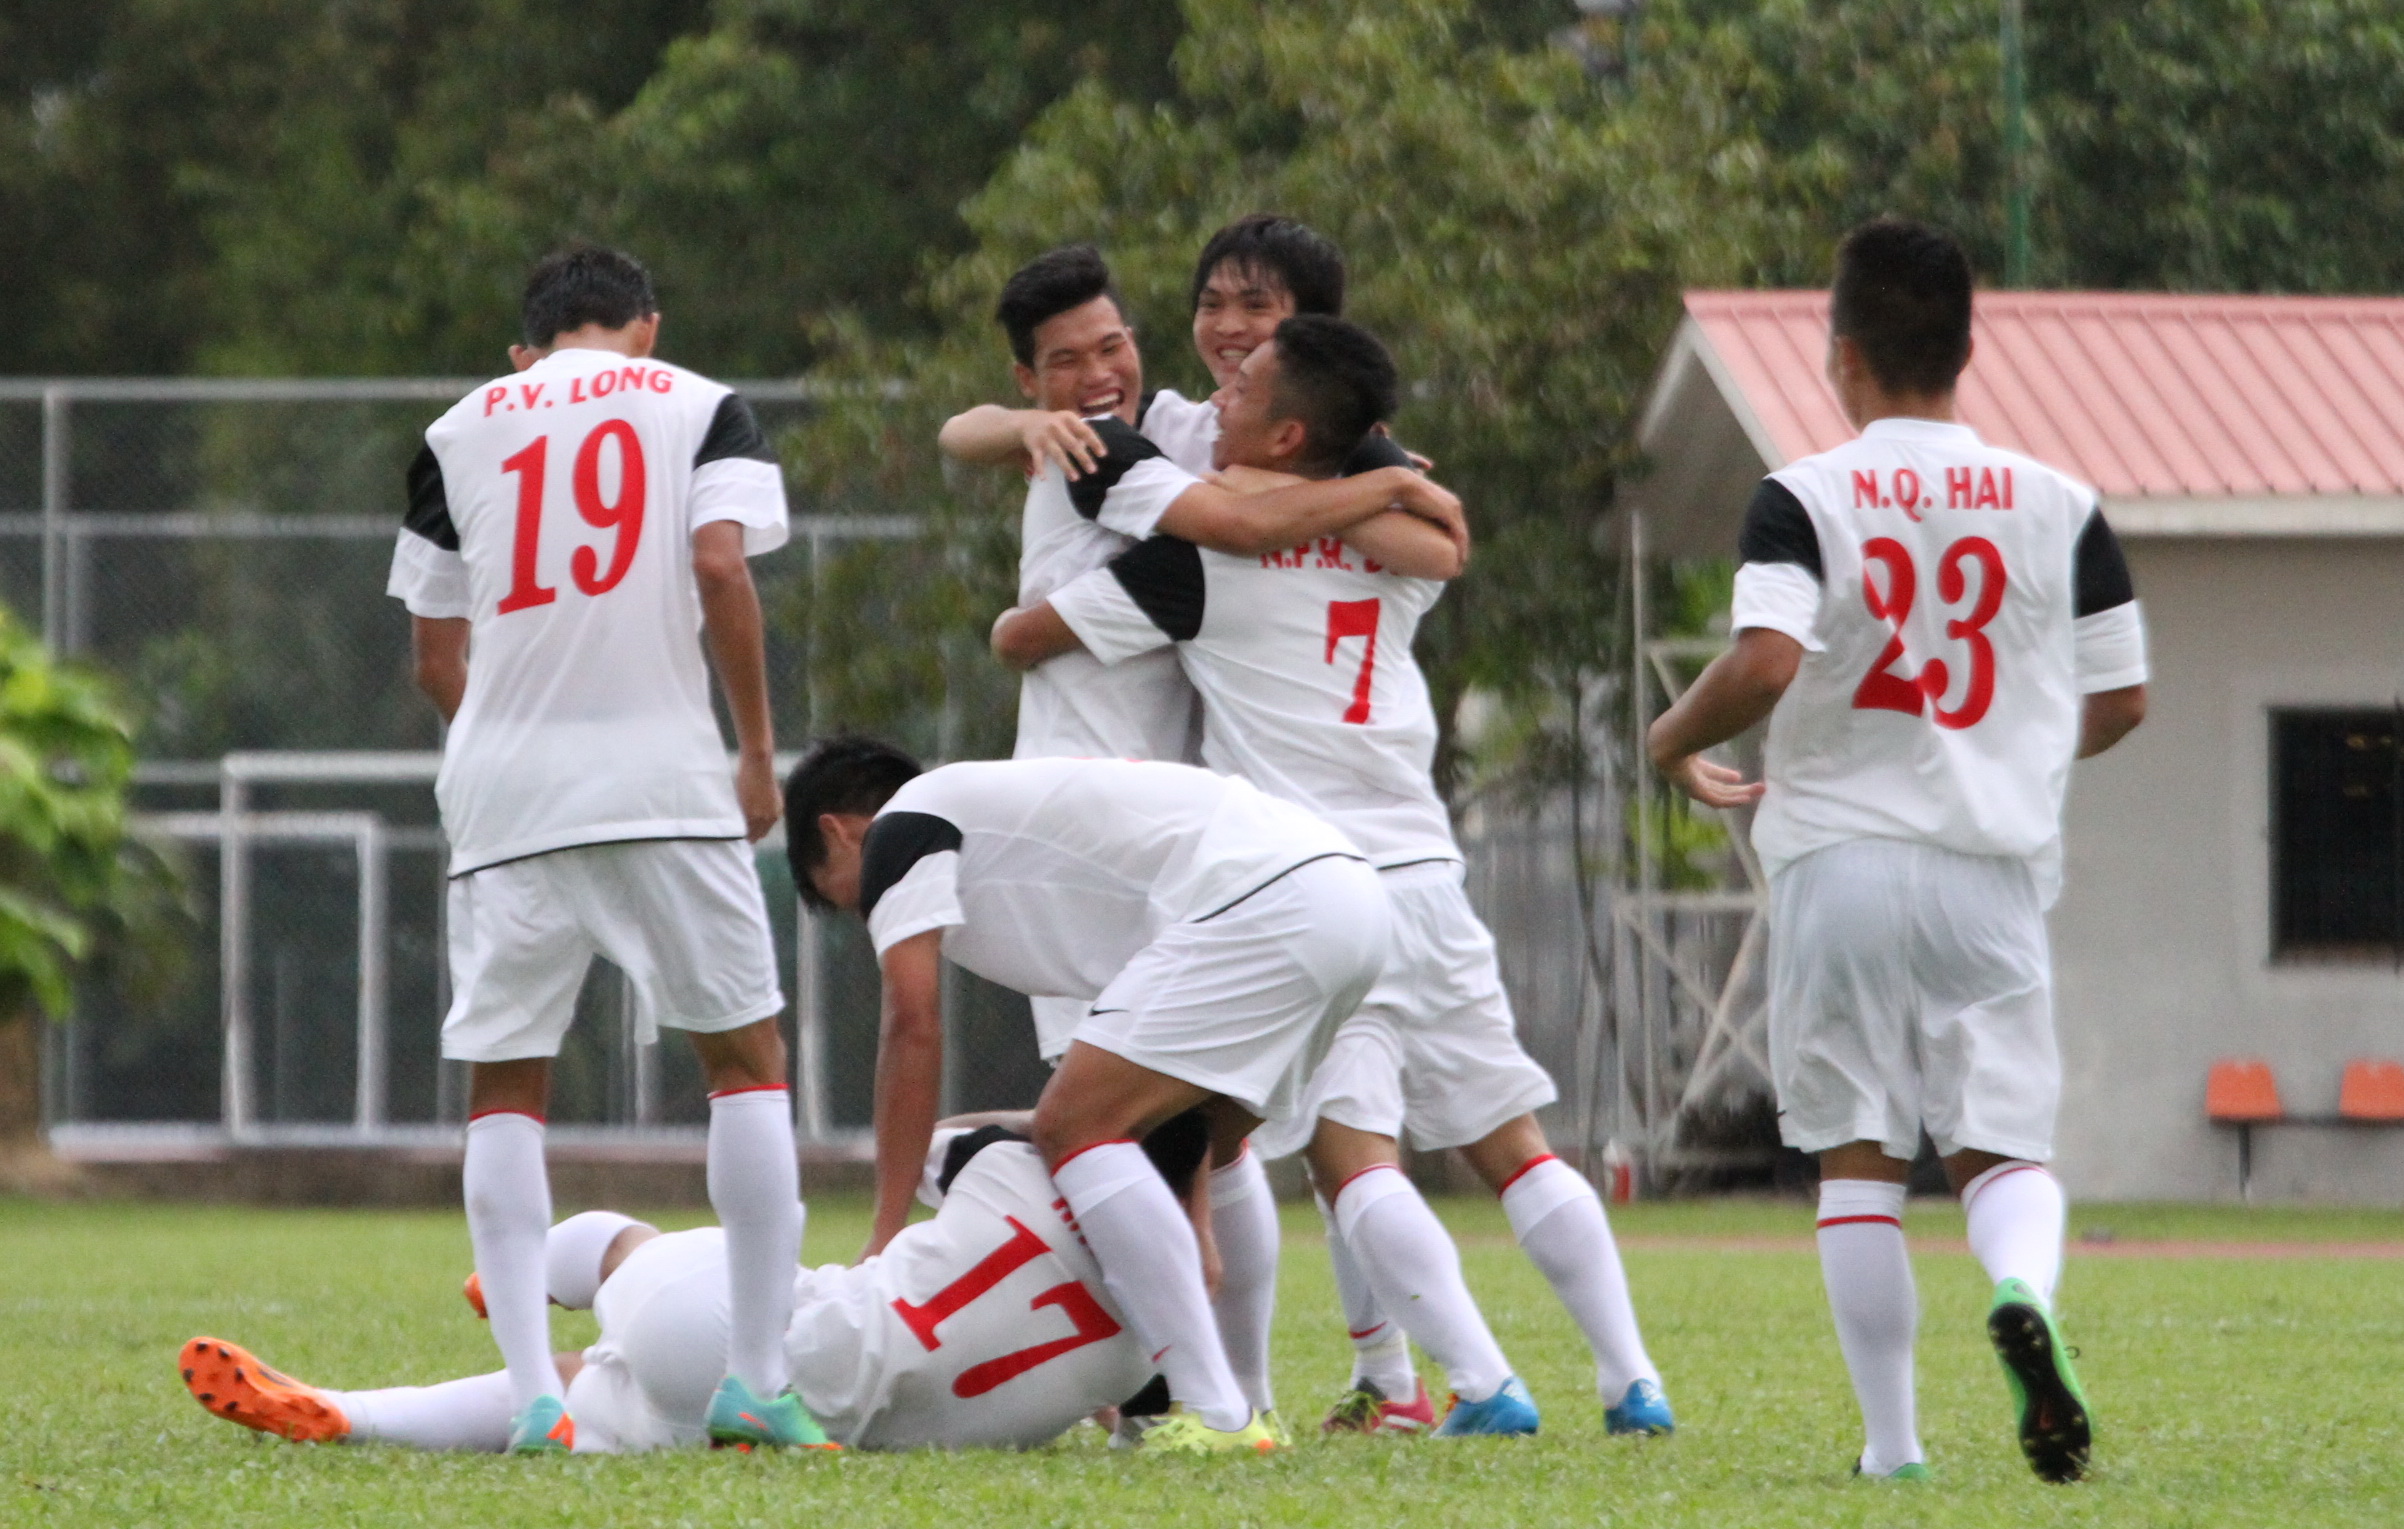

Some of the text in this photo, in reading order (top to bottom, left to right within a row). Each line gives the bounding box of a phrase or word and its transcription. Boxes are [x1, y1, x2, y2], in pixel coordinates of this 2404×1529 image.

[484, 366, 673, 418] P.V. LONG
[497, 417, 648, 616] 19
[1851, 466, 2014, 523] N.Q. HAI
[1324, 597, 1381, 725] 7
[1851, 535, 2008, 731] 23
[889, 1214, 1122, 1399] 17
